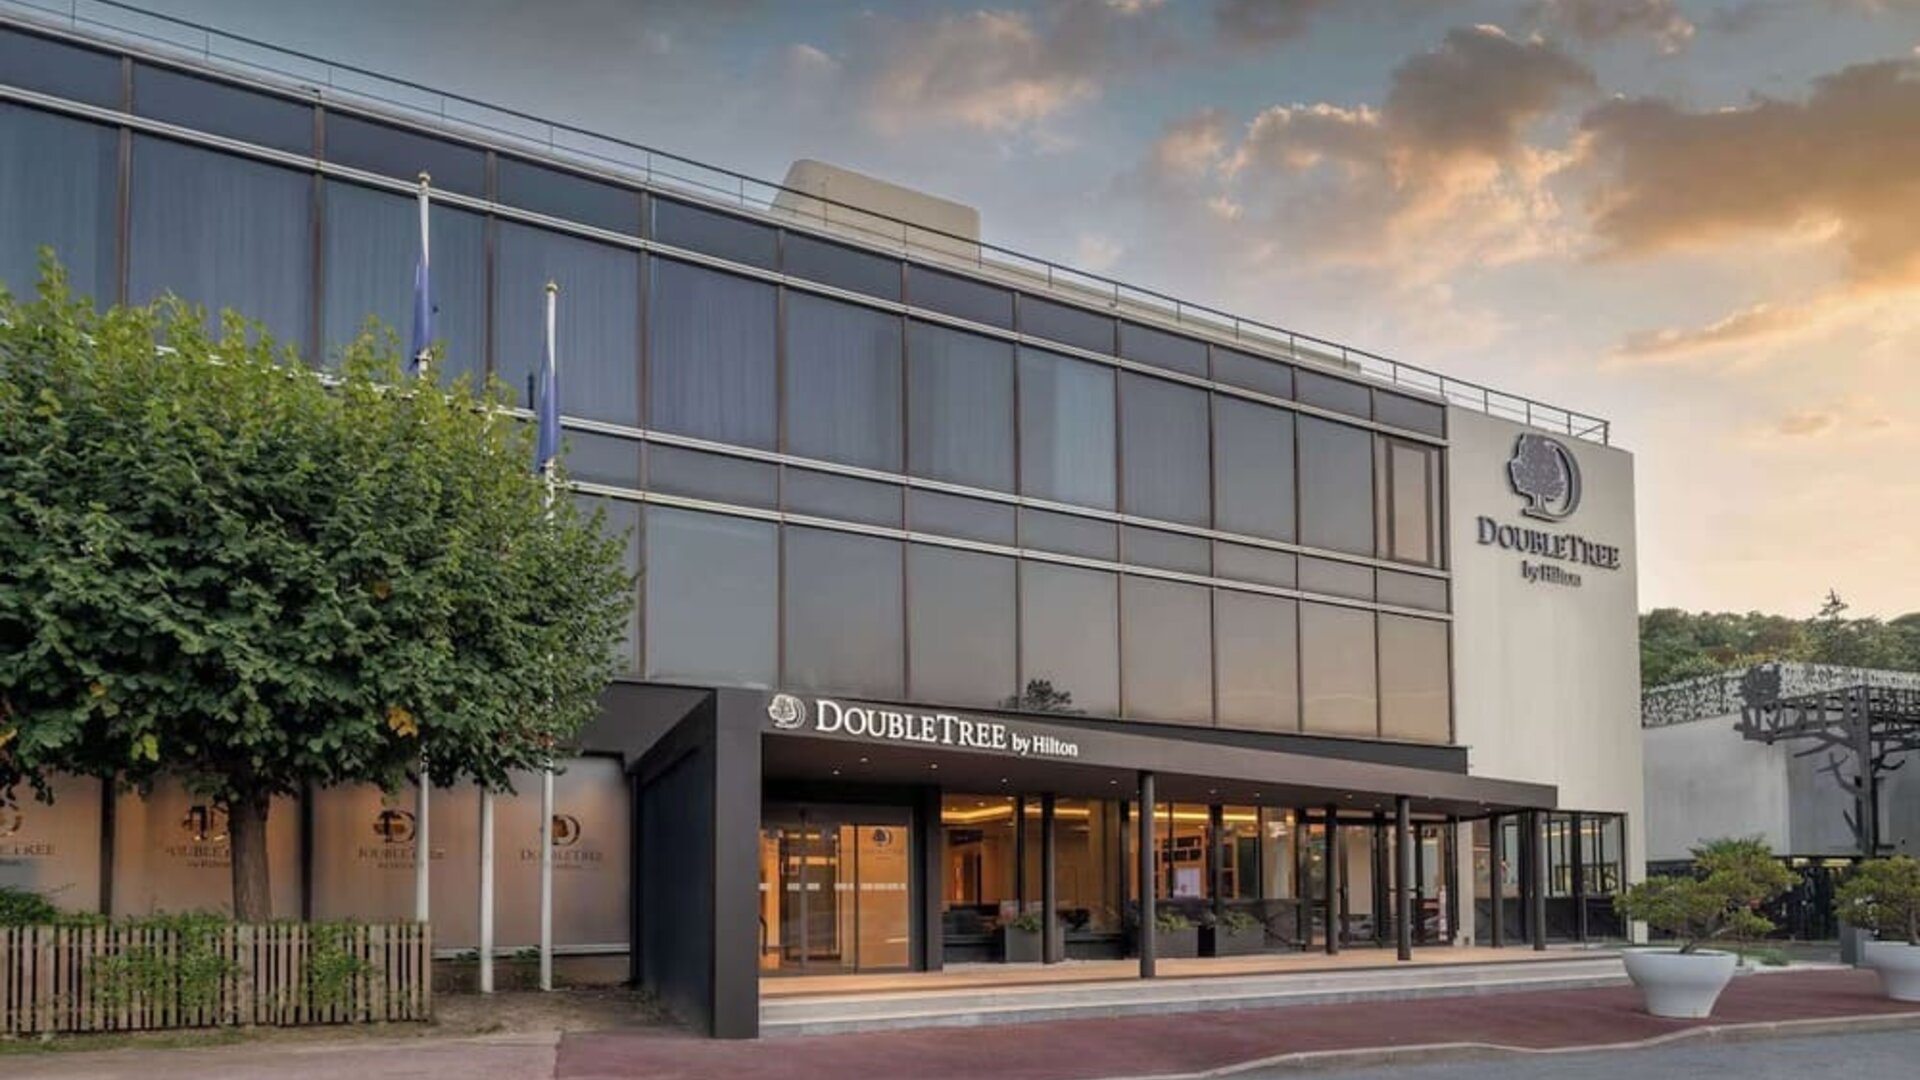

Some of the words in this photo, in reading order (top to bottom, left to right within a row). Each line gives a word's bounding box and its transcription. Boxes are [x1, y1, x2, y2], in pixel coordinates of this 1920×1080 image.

[1522, 559, 1538, 584] by
[1012, 732, 1031, 756] by
[1033, 735, 1079, 758] Hilton
